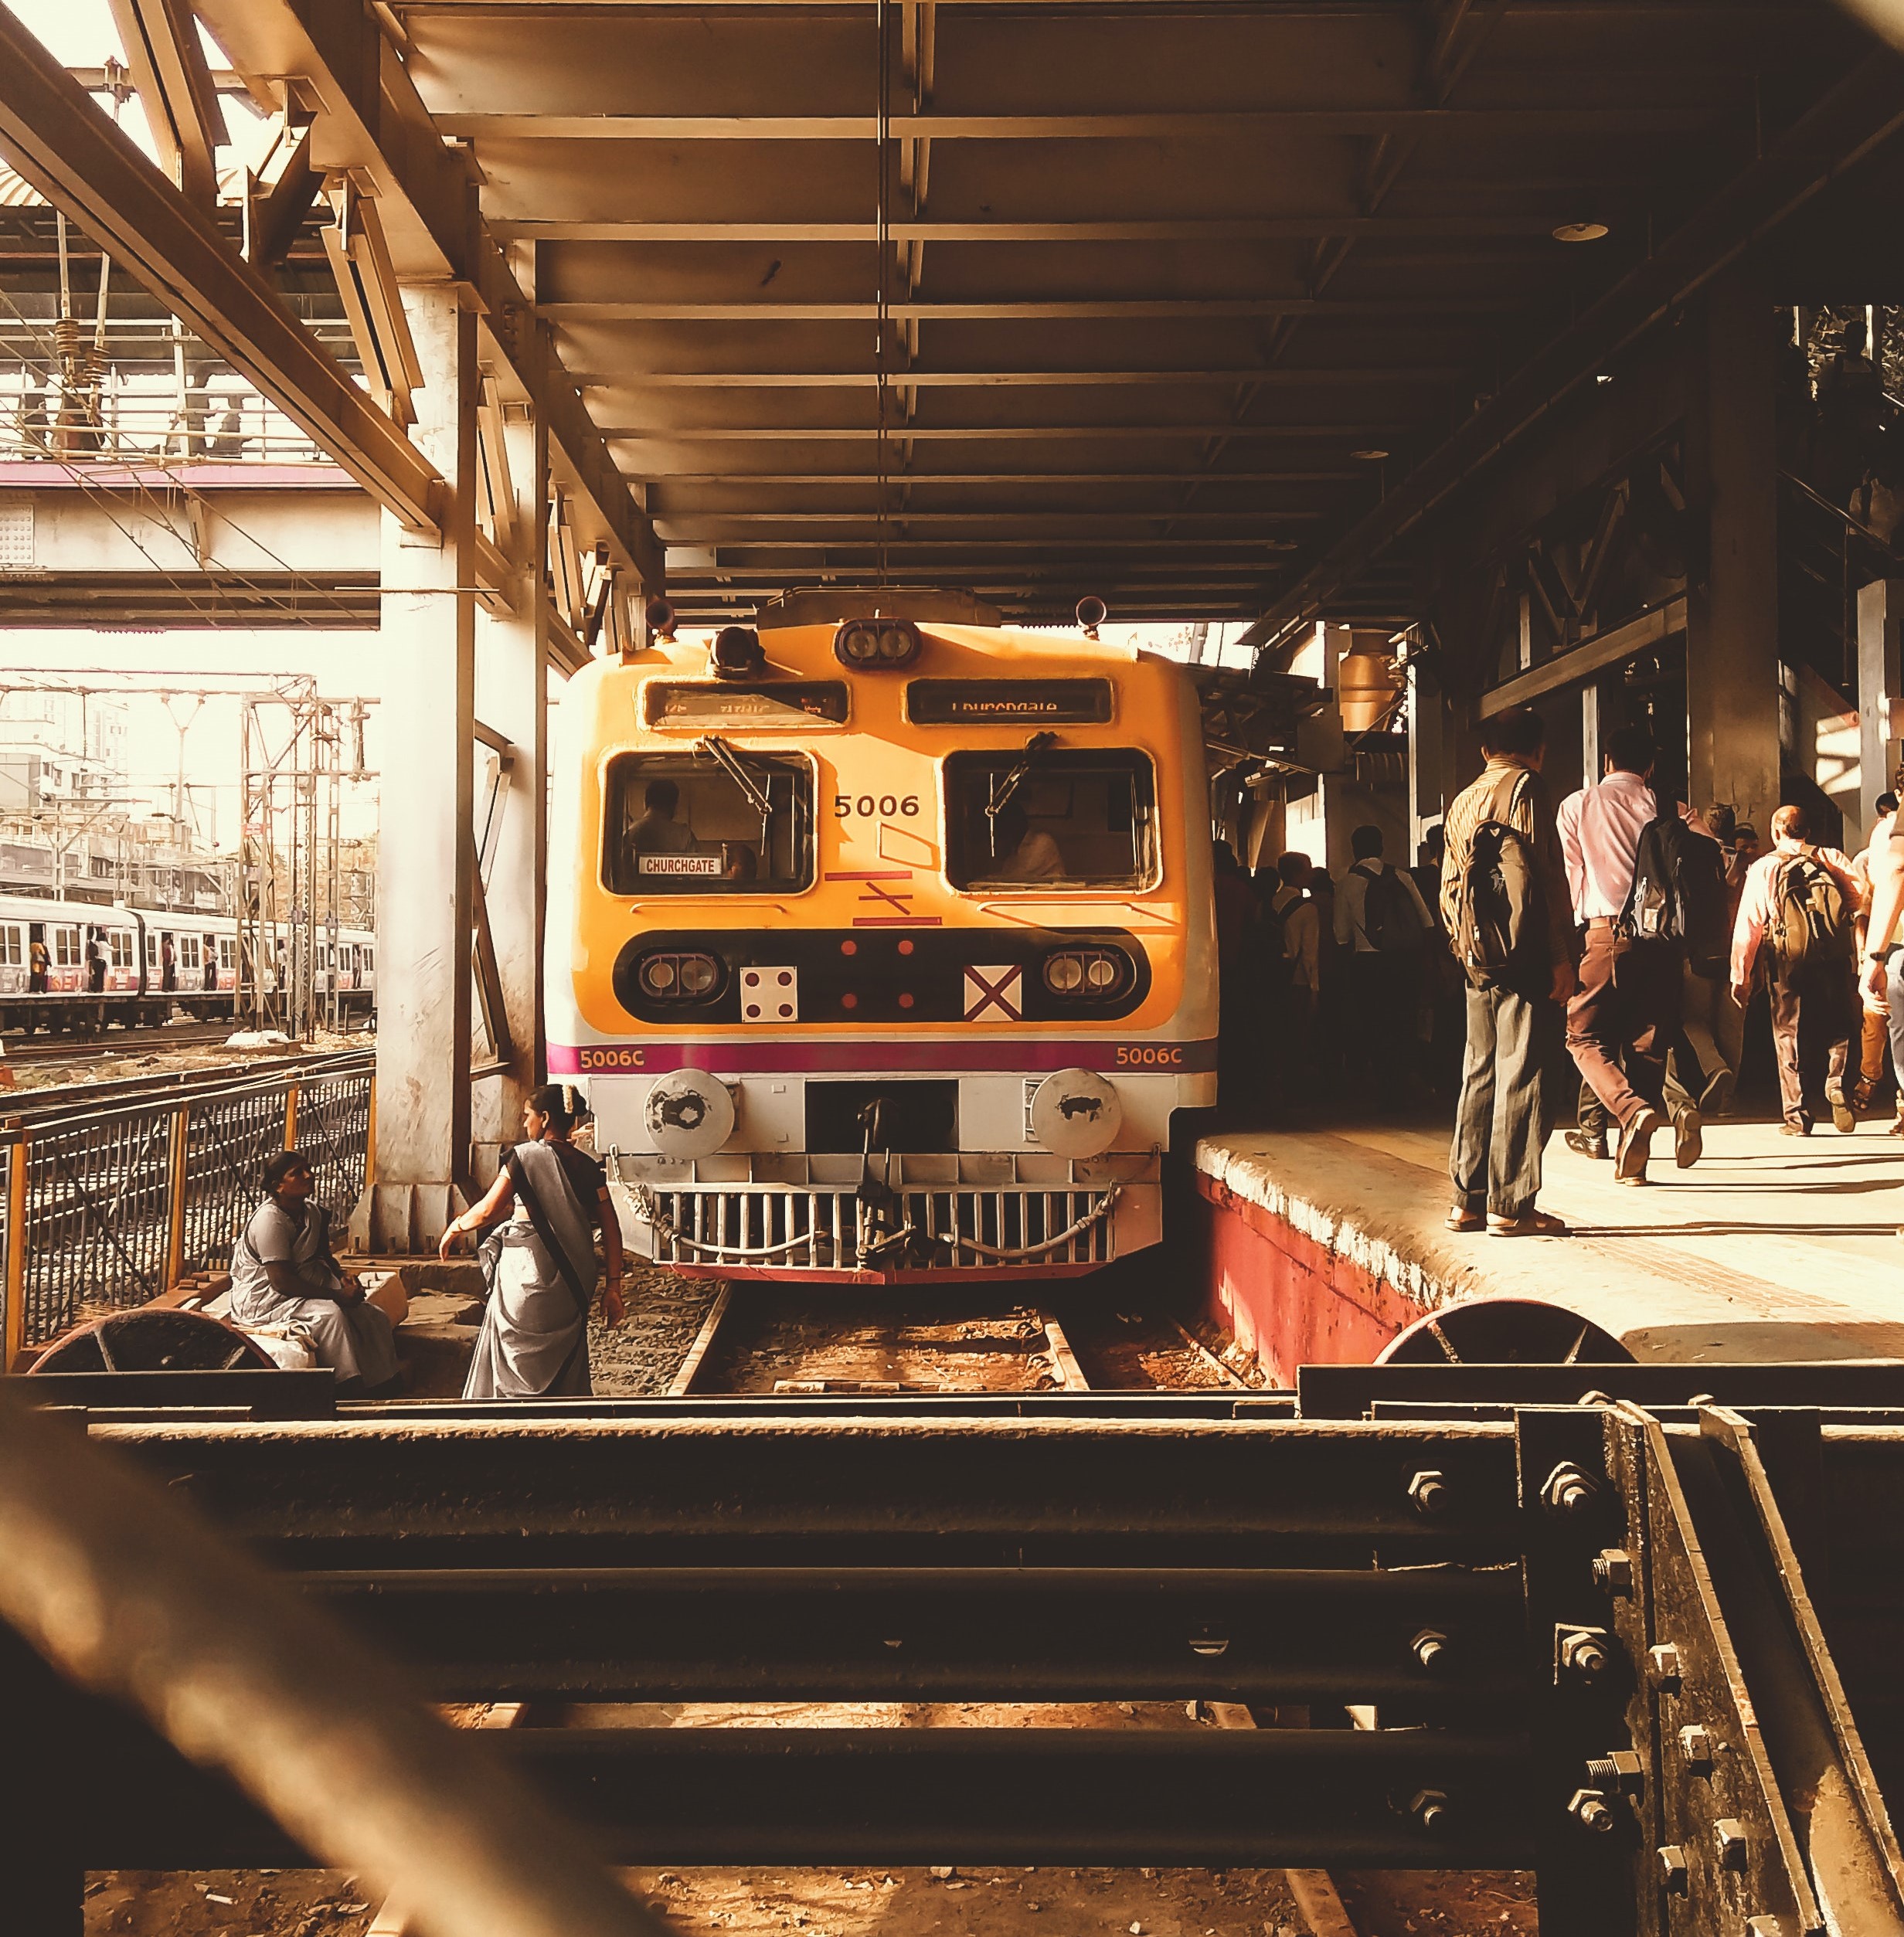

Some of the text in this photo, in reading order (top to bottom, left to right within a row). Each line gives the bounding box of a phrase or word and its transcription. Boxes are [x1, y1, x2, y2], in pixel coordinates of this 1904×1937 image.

[835, 795, 920, 817] 5006
[646, 858, 715, 873] CHURCHGATE
[580, 1050, 644, 1069] 5006C
[1116, 1047, 1182, 1065] 5006C
